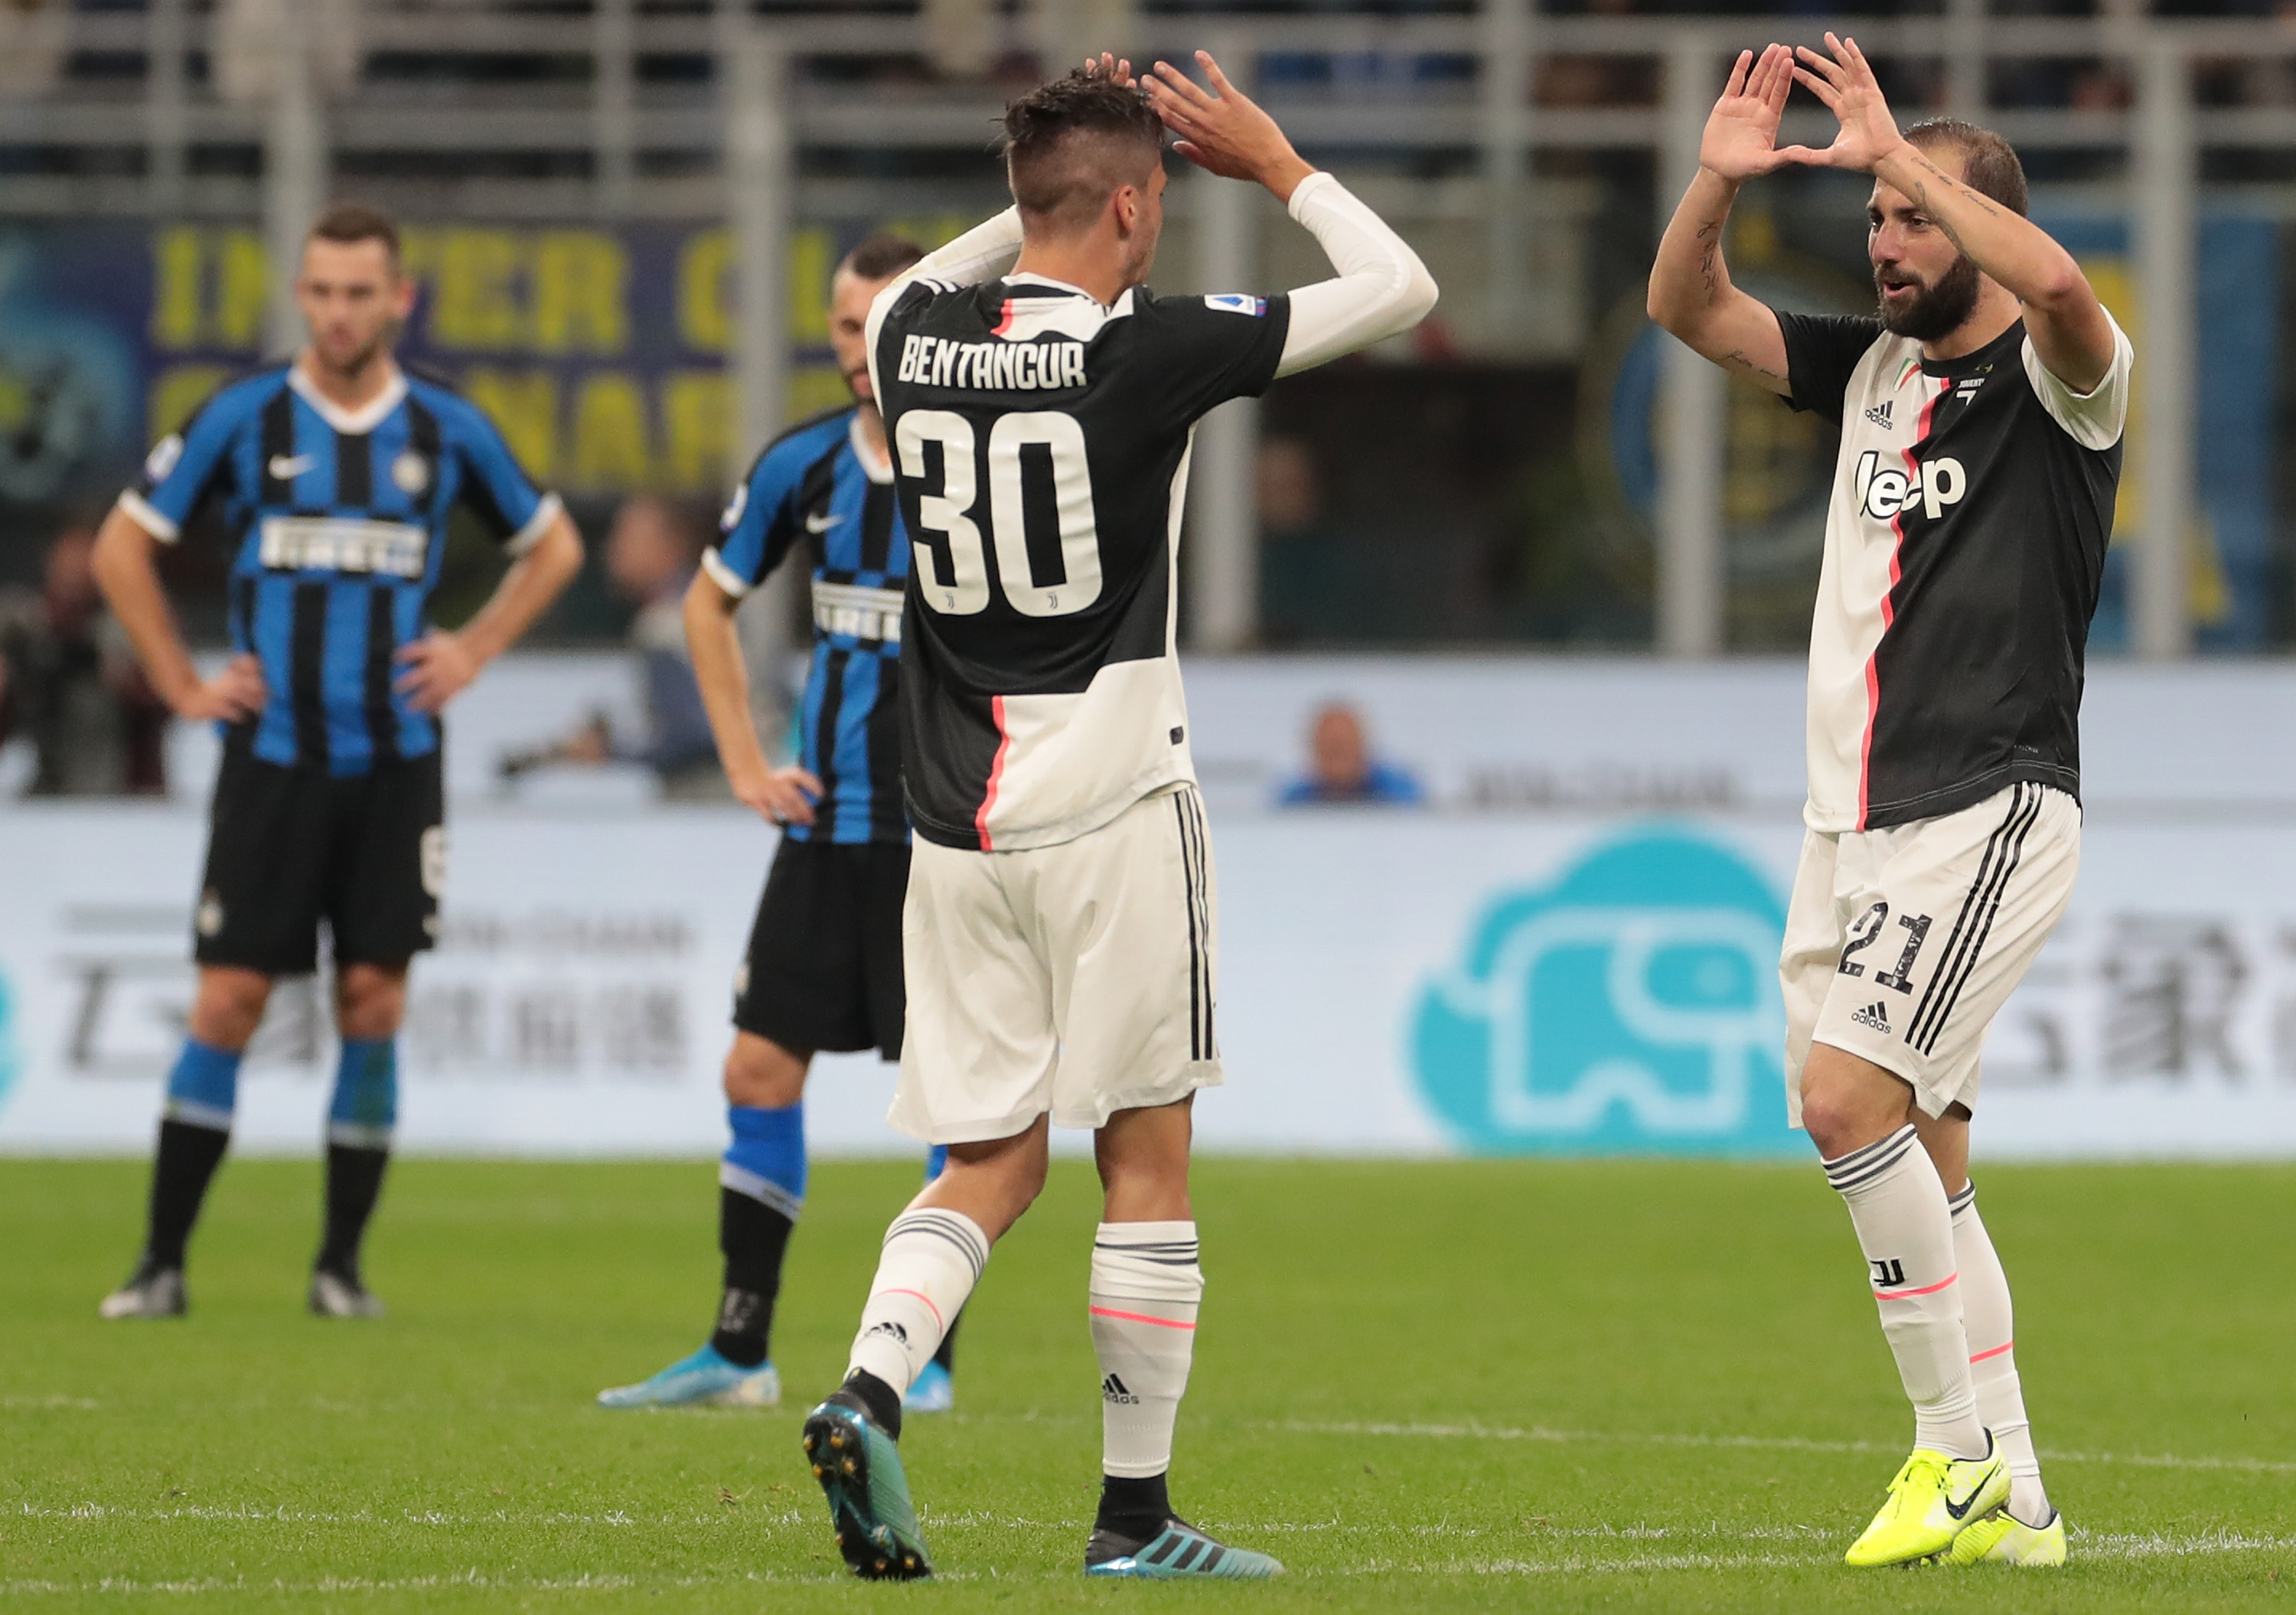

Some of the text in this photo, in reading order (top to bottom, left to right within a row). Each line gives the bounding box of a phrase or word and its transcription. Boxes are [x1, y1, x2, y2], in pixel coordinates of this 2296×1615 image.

[897, 334, 1087, 390] BENTANCUR
[895, 409, 1103, 618] 30
[1854, 450, 1967, 520] Jeep
[1837, 901, 1934, 996] 21
[1851, 1011, 1893, 1034] adidas
